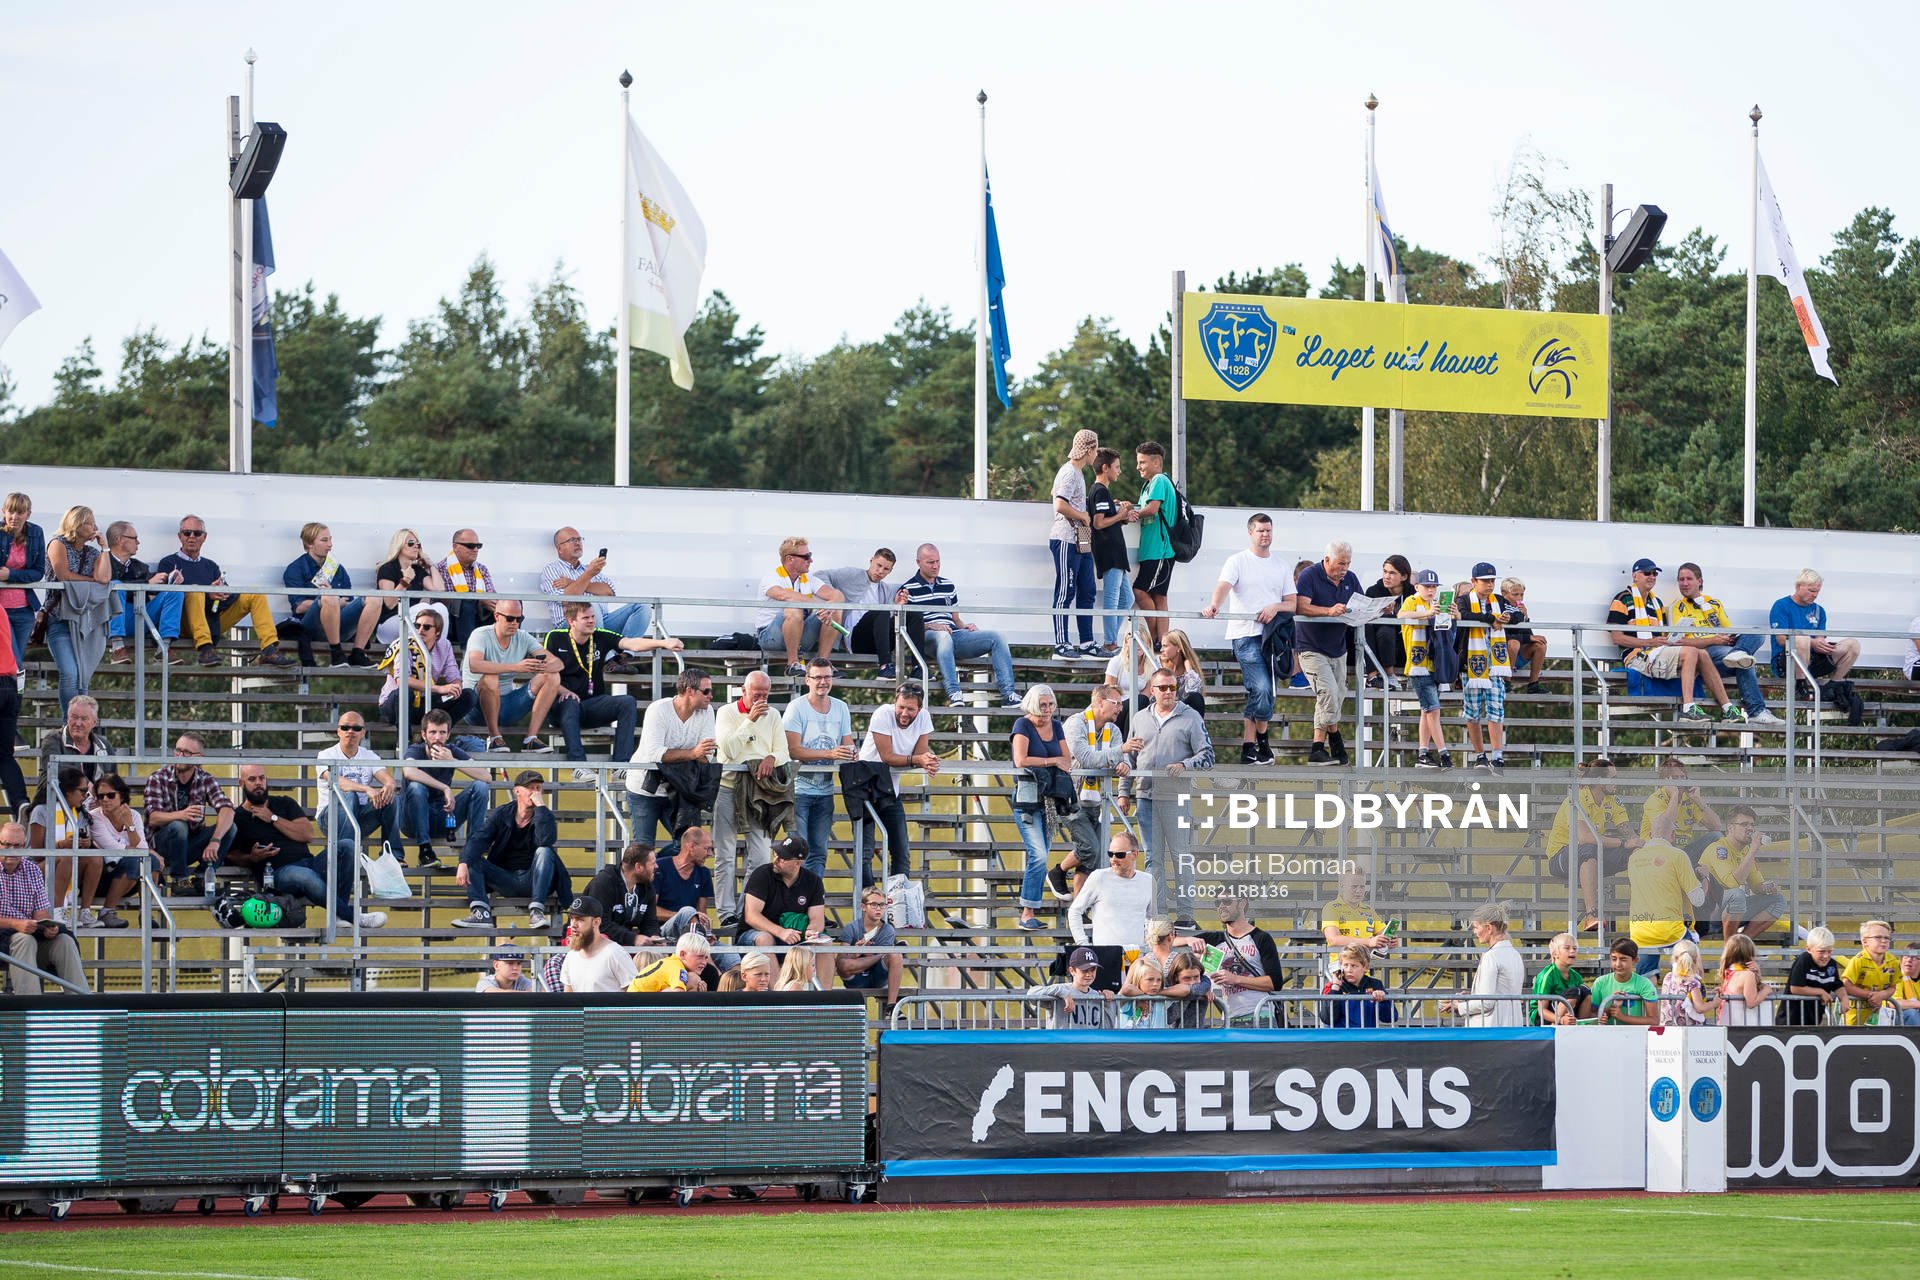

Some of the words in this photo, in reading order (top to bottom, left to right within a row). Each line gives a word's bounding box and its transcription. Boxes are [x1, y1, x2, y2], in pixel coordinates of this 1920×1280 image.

[1228, 365, 1250, 376] 1928
[1296, 334, 1375, 381] Laget
[1383, 340, 1429, 372] vid
[1429, 341, 1499, 375] havet
[121, 1047, 443, 1133] colorama
[548, 1041, 843, 1124] colorama
[1024, 1066, 1472, 1134] ENGELSONS
